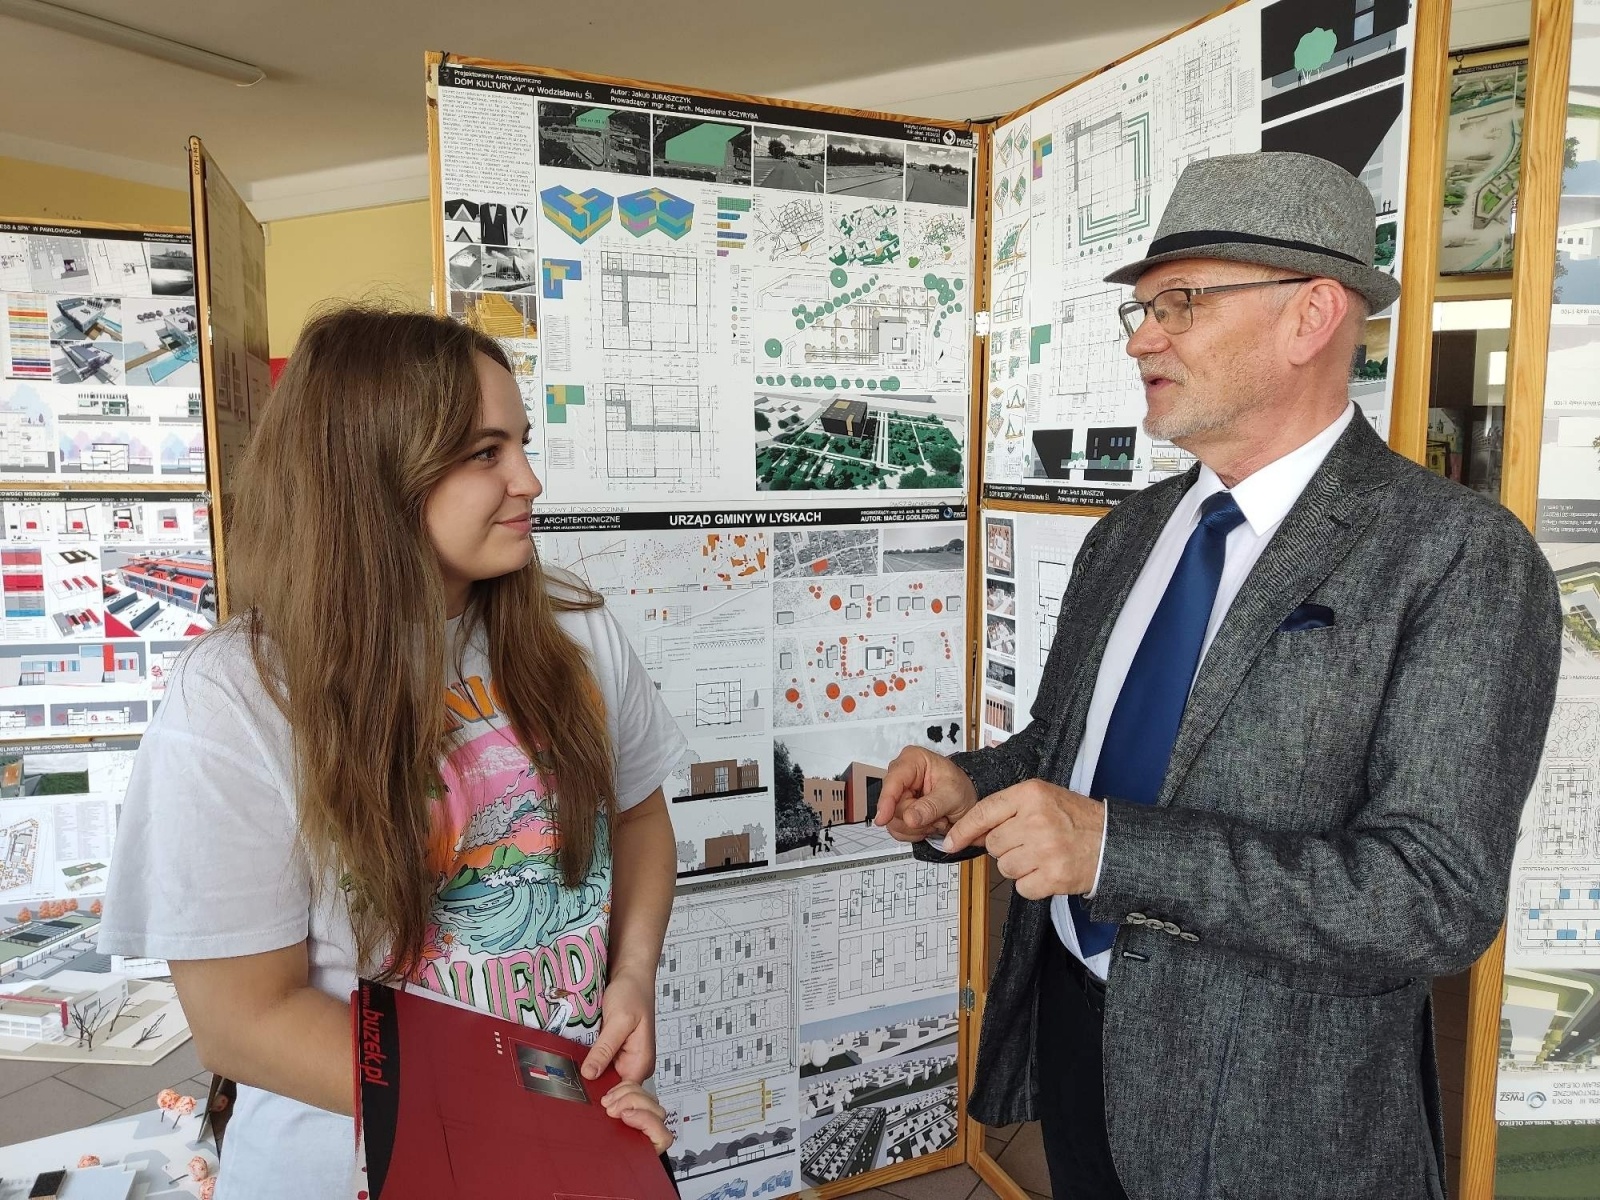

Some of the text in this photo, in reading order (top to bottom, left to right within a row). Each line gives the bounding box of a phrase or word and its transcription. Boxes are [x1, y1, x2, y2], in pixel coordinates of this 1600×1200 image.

[454, 70, 542, 85] Projektowanie Architektoniczne
[454, 78, 474, 87] DOM
[476, 81, 512, 91] KULTURY
[537, 87, 583, 99] Wodzisławiu
[610, 88, 692, 104] Autor: Jakub JURASZCZYK
[651, 101, 663, 110] mgr
[678, 104, 693, 112] arch.
[695, 106, 727, 117] Magdalena
[544, 516, 620, 524] ARCHITEKTONICZNE
[669, 512, 822, 527] URZĄD GMINY W LYSKACH
[1500, 1094, 1525, 1102] PWSZ
